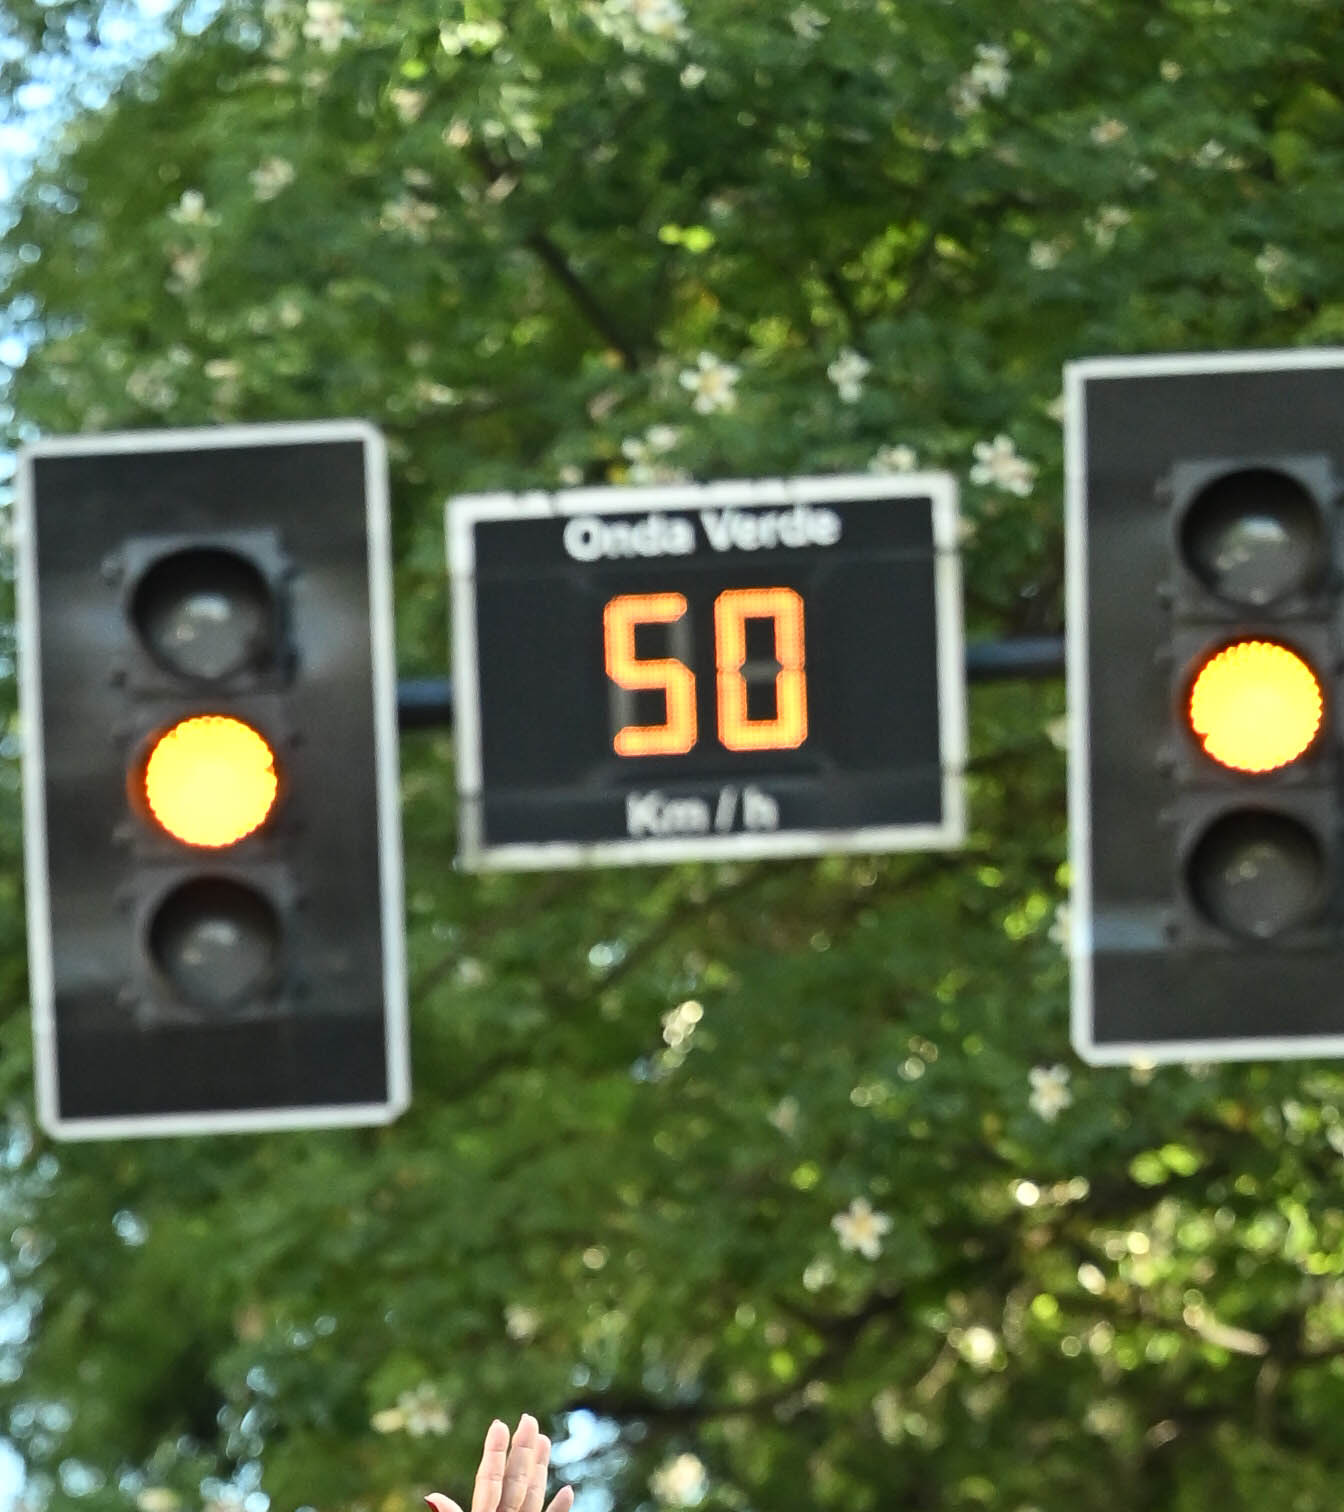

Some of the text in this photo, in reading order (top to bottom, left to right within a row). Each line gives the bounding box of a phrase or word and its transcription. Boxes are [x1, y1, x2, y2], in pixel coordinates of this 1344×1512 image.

[564, 504, 843, 562] Onda Verde
[603, 587, 808, 757] 50
